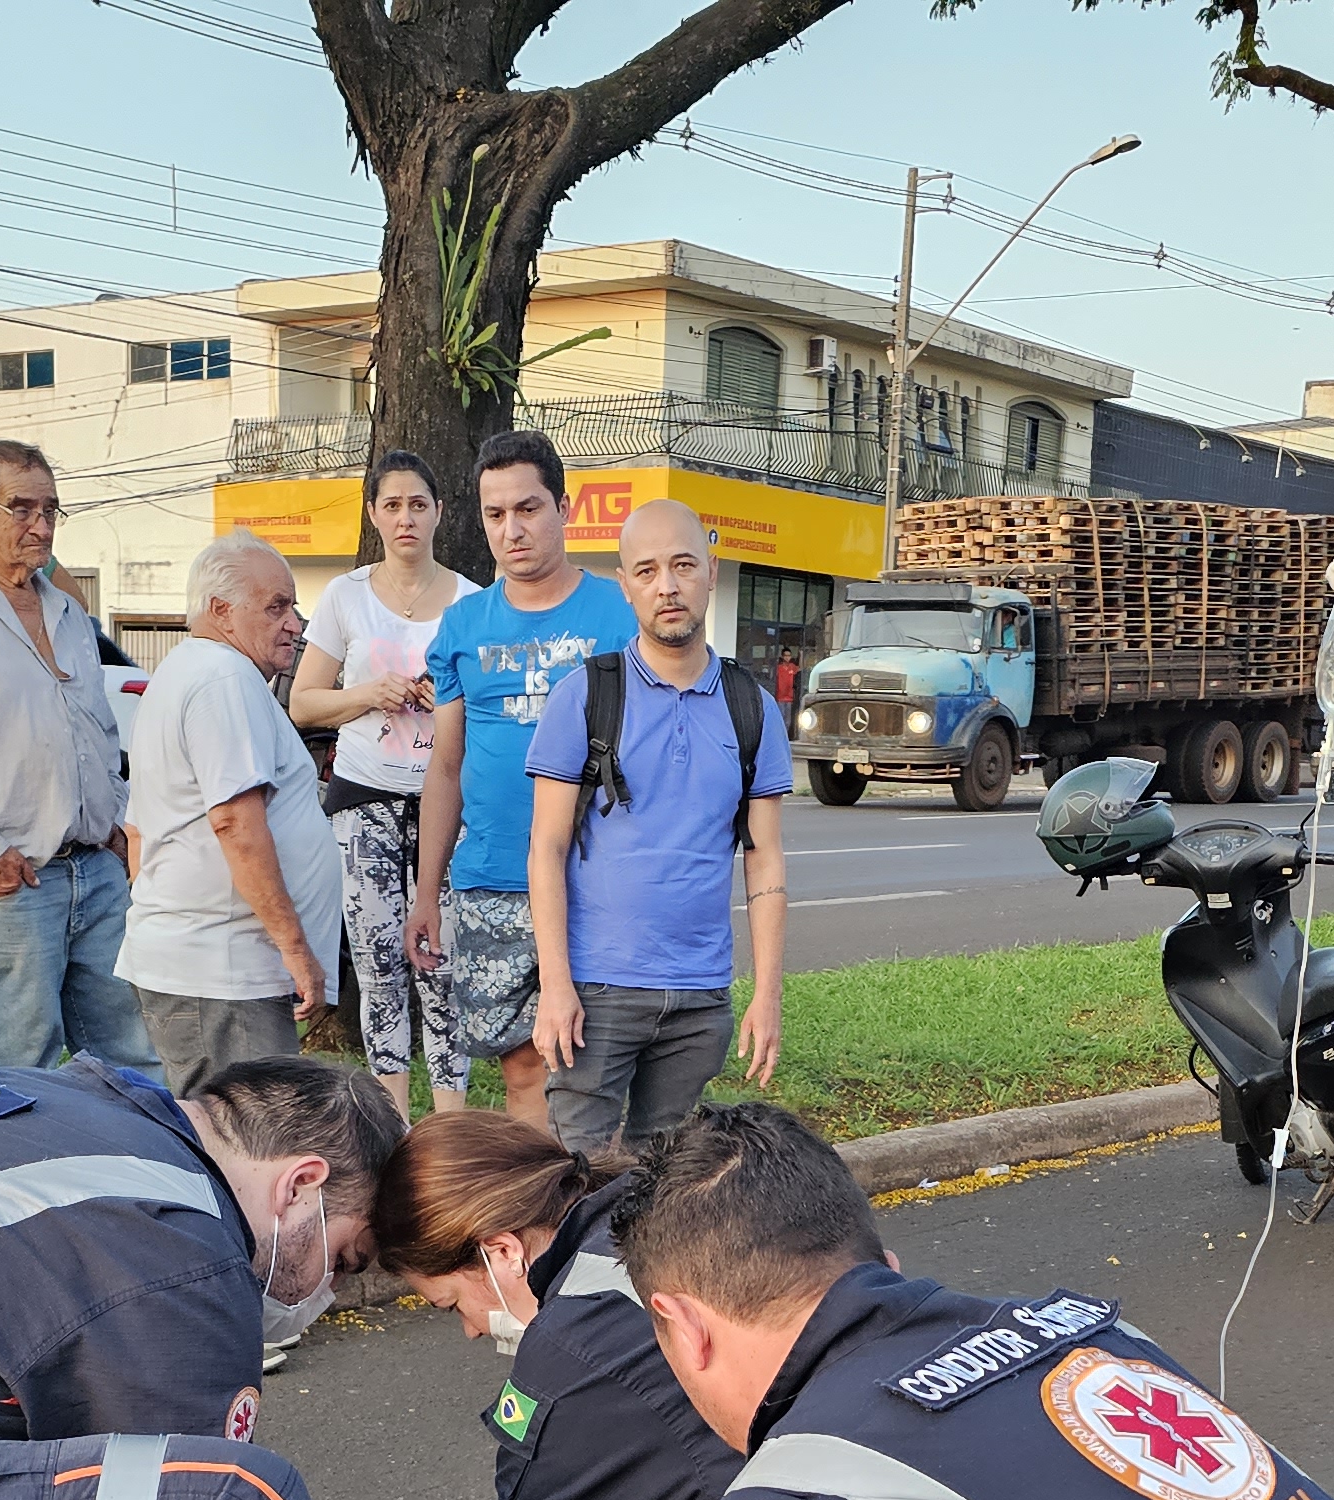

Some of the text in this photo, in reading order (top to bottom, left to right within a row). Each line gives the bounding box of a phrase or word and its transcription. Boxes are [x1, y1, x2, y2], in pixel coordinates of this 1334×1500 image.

[478, 636, 598, 673] VICTORY
[525, 669, 550, 695] IS
[898, 1329, 1039, 1400] CONDUTOR
[1072, 1428, 1128, 1474] SERVIÇO
[1255, 1470, 1270, 1486] DE
